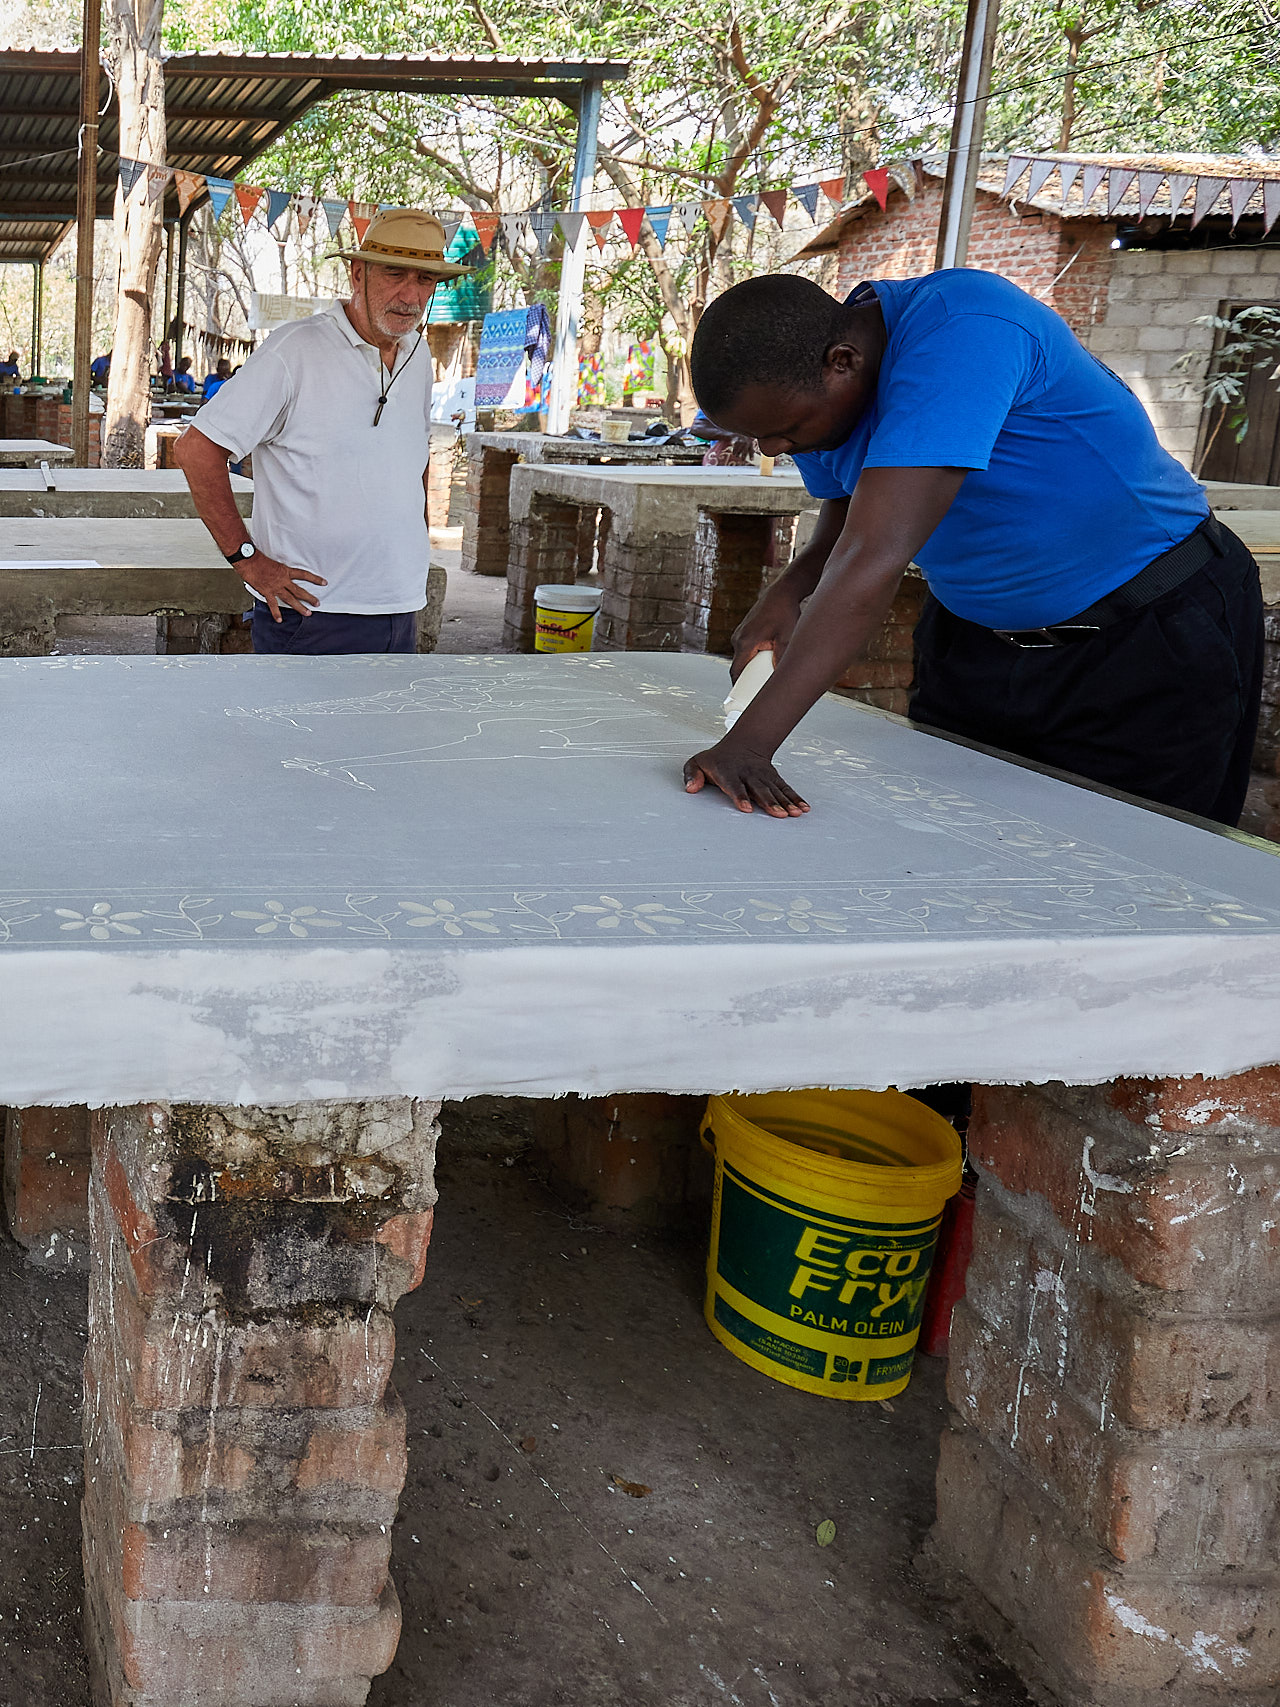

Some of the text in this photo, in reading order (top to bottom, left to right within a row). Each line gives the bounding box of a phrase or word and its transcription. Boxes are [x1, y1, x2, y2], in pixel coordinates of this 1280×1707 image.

[794, 1226, 920, 1276] Eco
[788, 1264, 912, 1318] Fry
[790, 1304, 905, 1335] PALM OLEIN
[835, 1357, 848, 1367] 20
